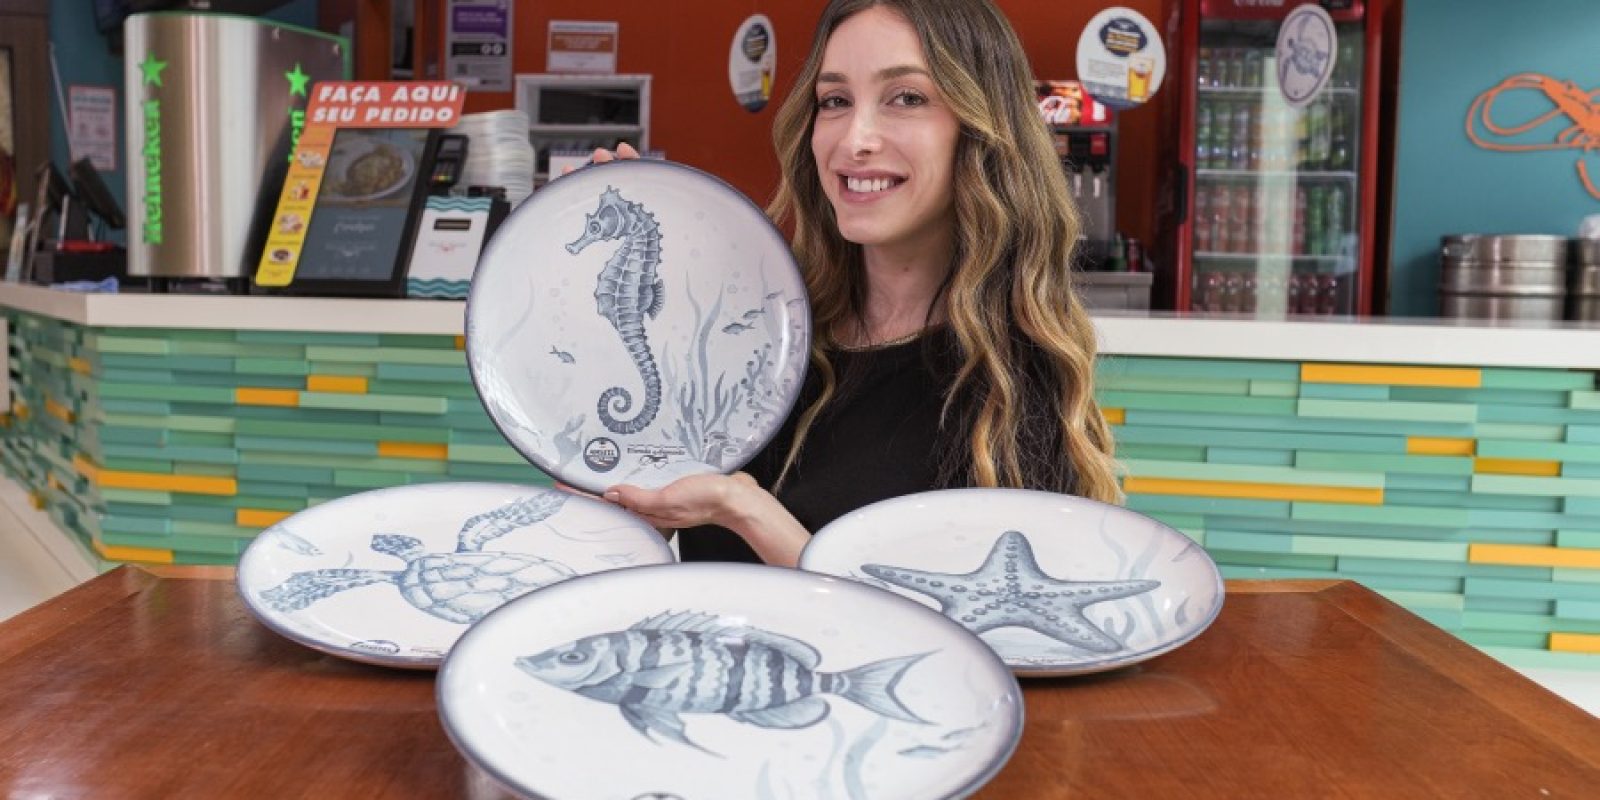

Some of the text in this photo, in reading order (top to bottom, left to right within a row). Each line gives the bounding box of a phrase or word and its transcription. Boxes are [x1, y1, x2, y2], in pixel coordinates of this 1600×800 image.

[319, 86, 459, 104] FAÇA AQUI
[313, 107, 453, 122] SEU PEDIDO
[143, 99, 162, 244] Heineken
